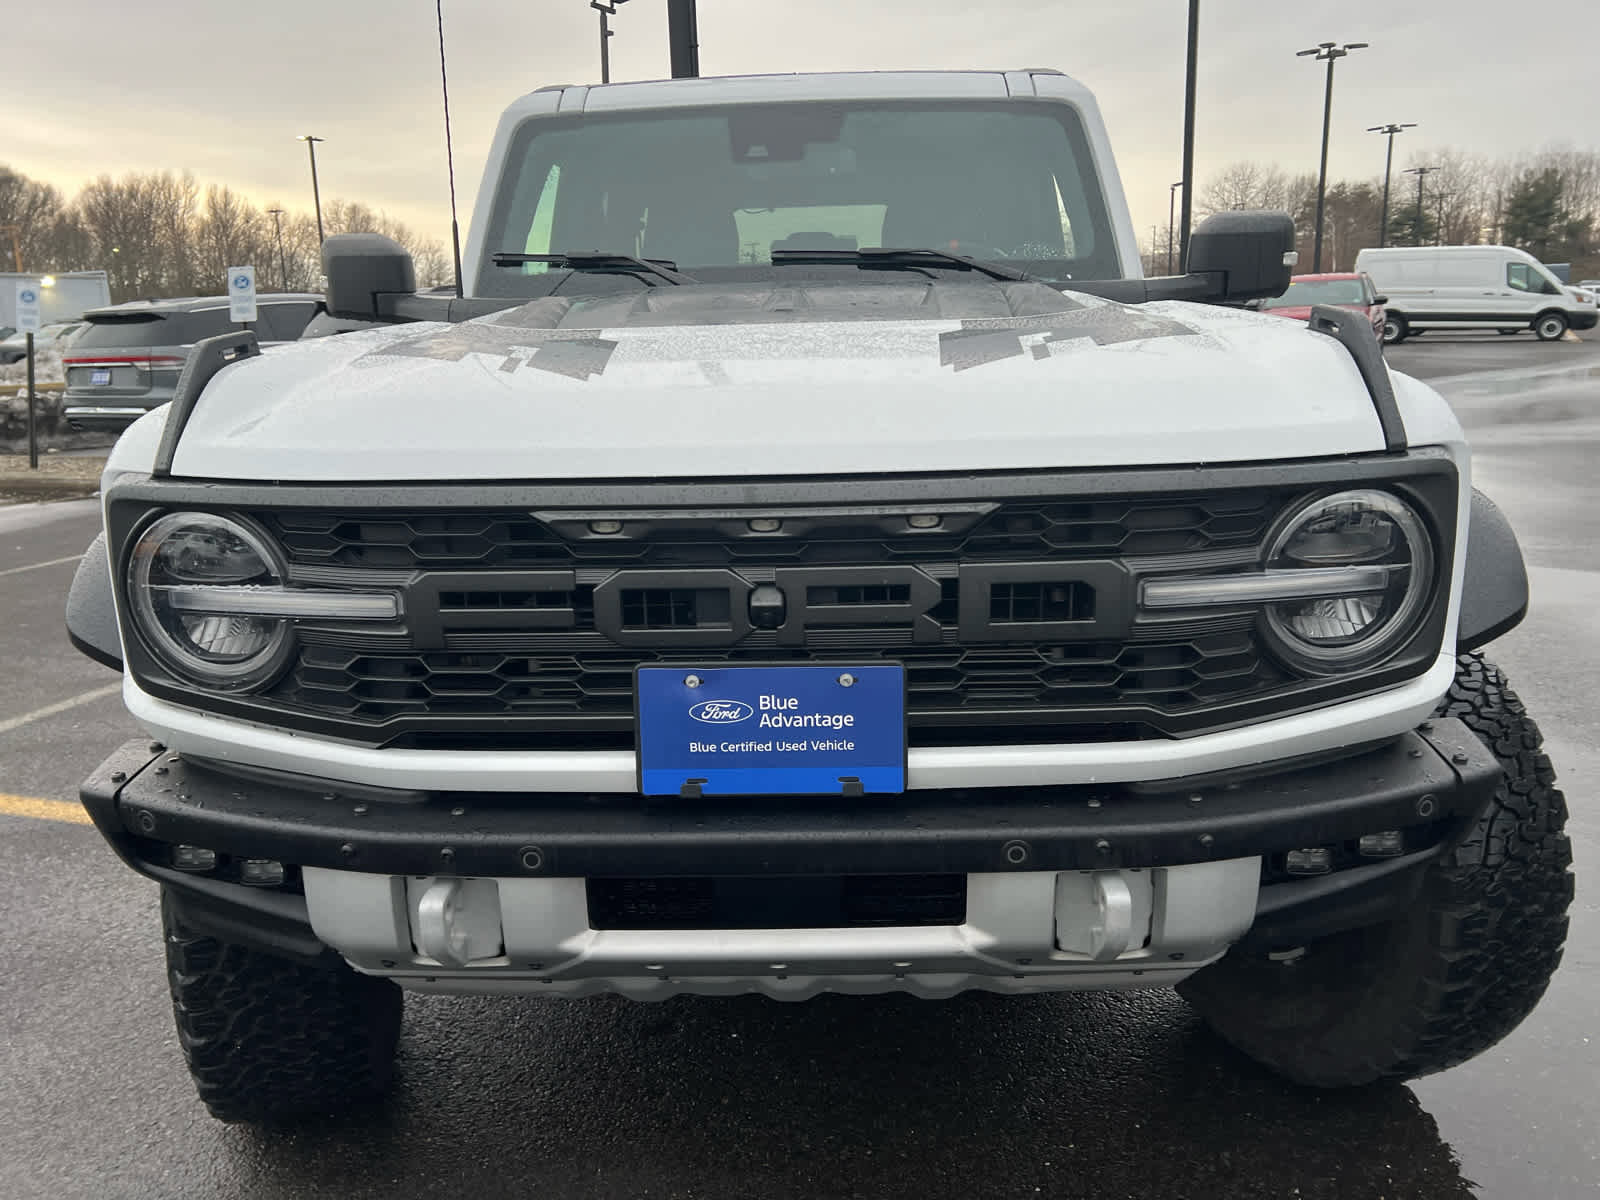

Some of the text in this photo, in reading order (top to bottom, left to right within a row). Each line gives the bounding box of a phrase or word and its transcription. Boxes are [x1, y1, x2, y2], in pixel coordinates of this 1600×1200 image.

[407, 559, 1133, 650] FORD
[700, 702, 742, 720] Ford
[759, 694, 799, 710] Blue
[759, 712, 855, 730] Advantage
[689, 739, 855, 753] Blue Certified Used Vehicle
